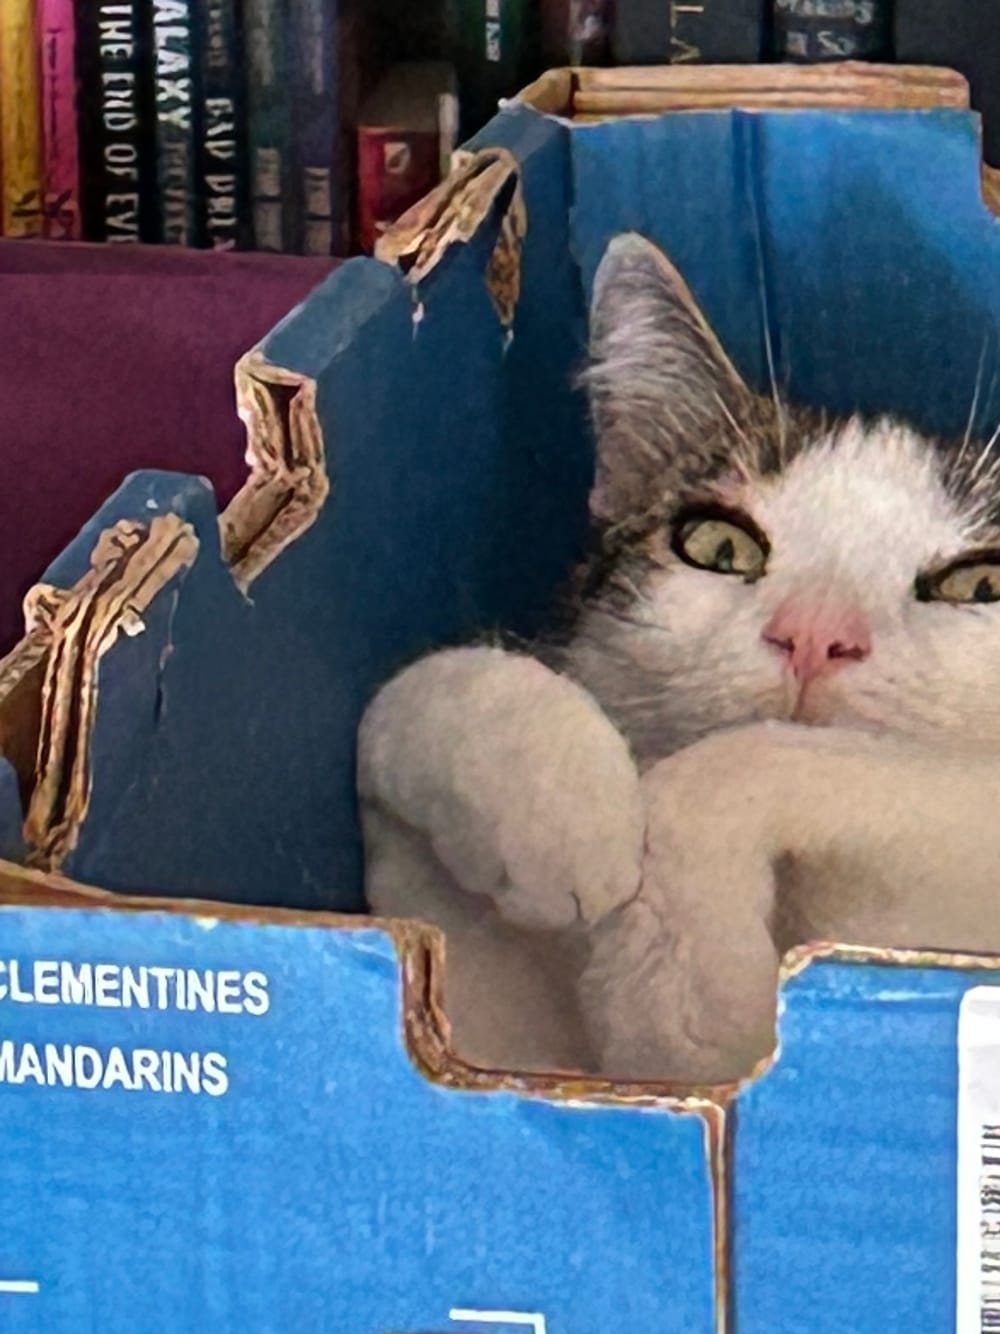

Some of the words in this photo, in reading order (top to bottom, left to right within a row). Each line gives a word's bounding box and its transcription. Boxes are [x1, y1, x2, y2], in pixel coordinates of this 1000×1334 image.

[98, 4, 134, 59] THE
[101, 72, 138, 131] END
[103, 143, 140, 182] OF
